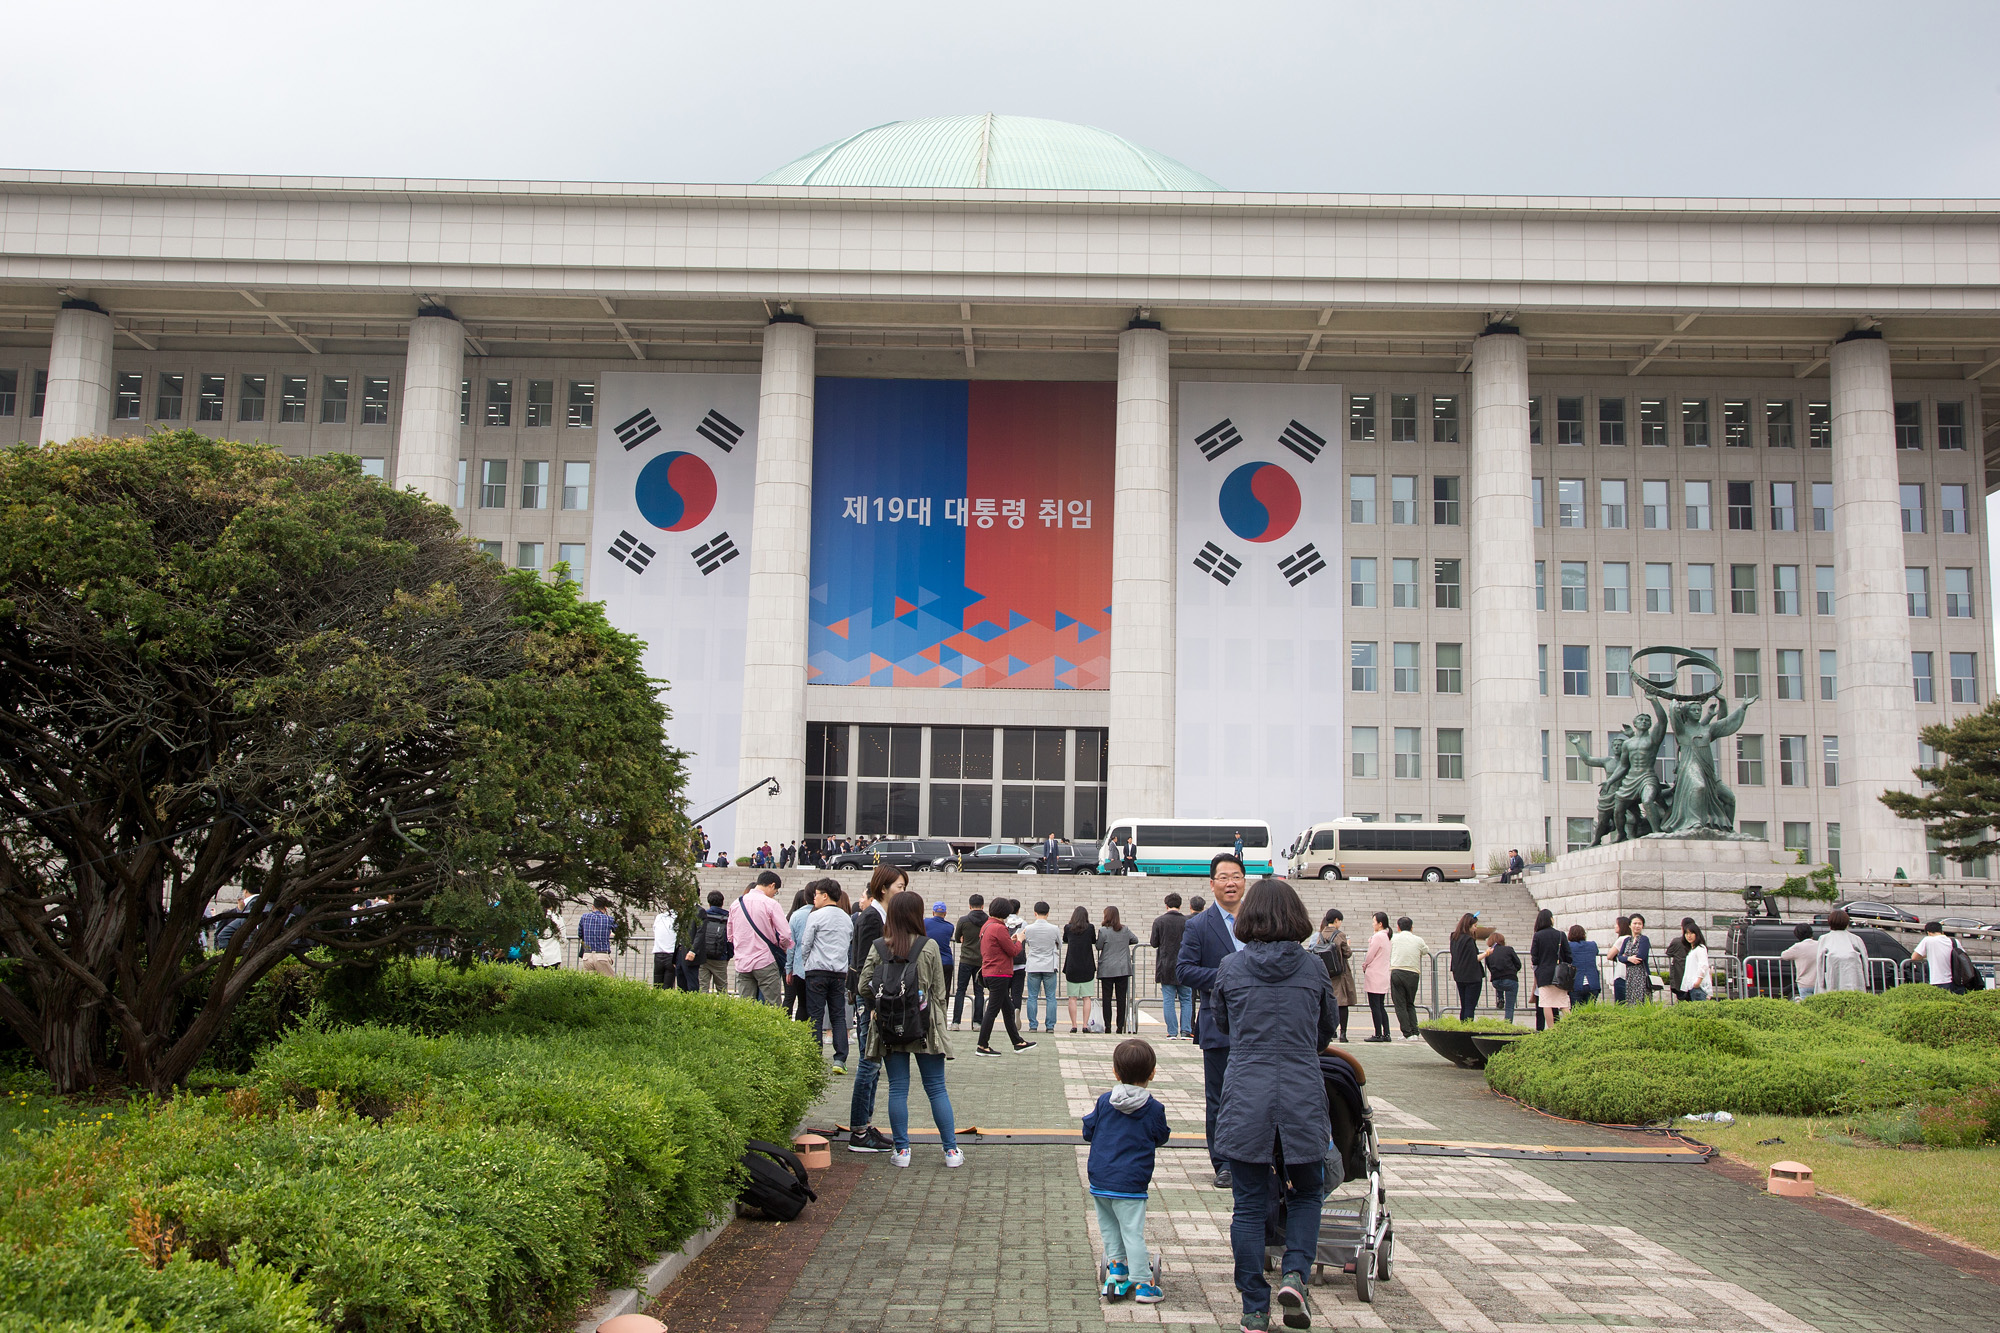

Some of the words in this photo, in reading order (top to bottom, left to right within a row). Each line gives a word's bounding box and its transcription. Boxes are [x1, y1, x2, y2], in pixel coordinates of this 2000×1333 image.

[842, 495, 931, 527] 제19대
[945, 497, 1026, 529] 대통령
[1038, 499, 1092, 529] 취임
